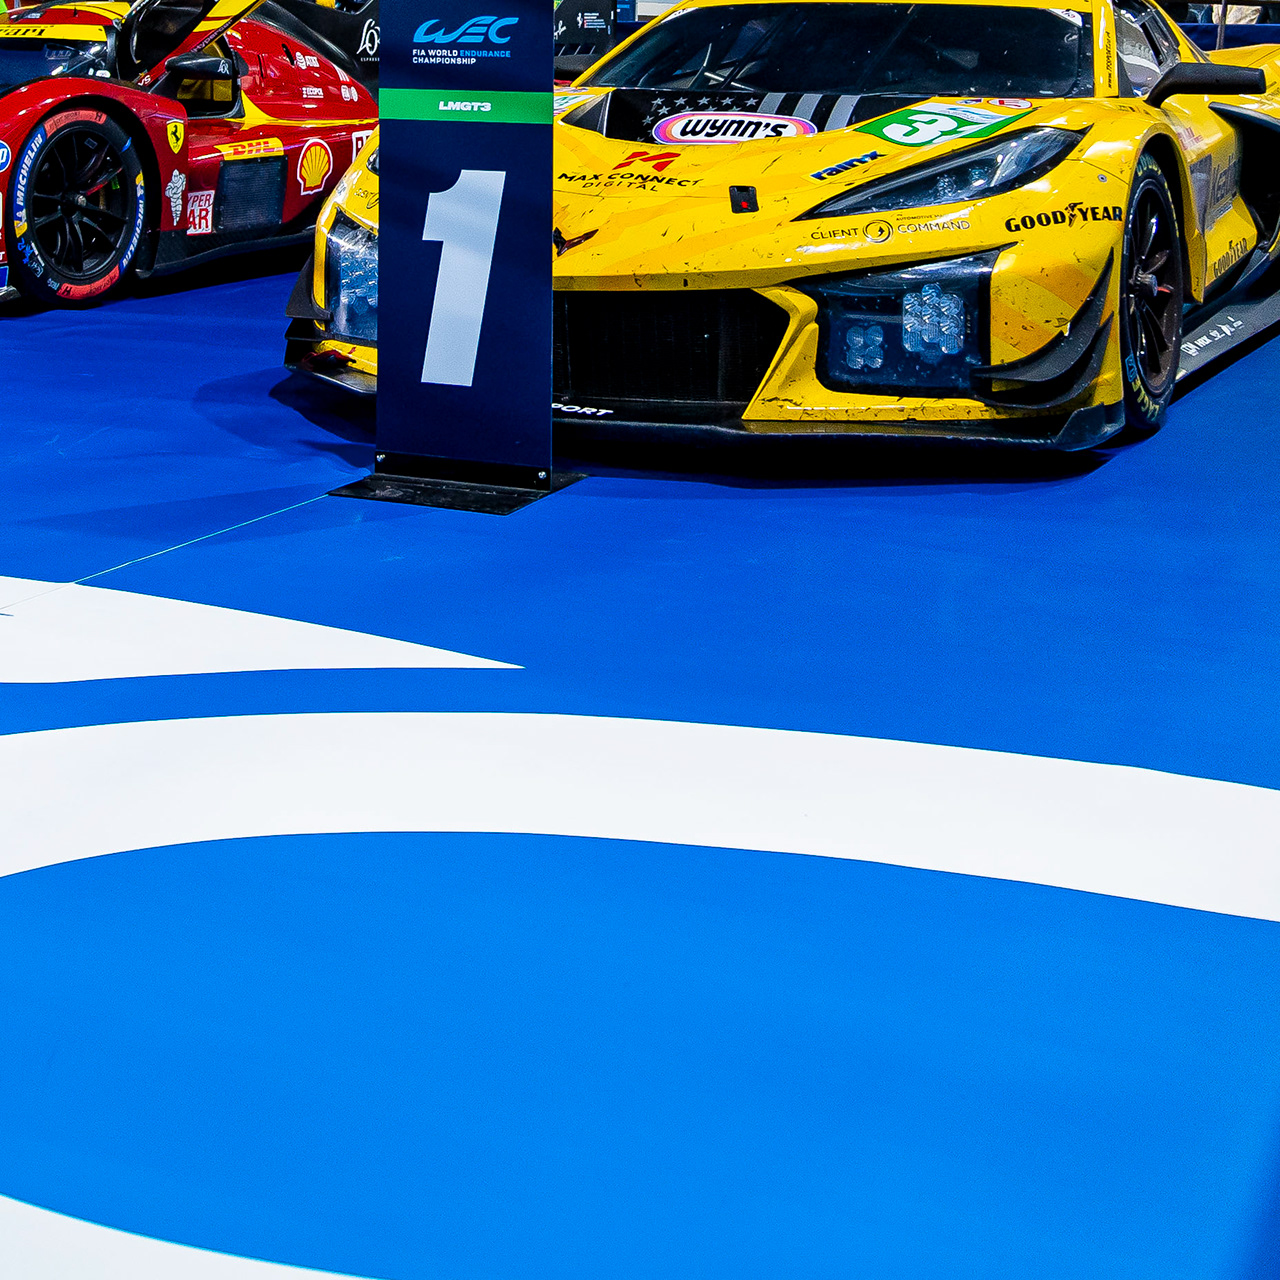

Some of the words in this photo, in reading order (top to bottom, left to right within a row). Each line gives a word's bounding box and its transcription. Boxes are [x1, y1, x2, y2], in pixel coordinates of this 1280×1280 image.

[413, 16, 519, 44] WEC
[413, 49, 426, 57] FIA
[428, 49, 458, 57] WORLD
[460, 50, 511, 58] ENDURANCE
[413, 57, 477, 65] CHAMPIONSHIP
[439, 101, 491, 111] LMGT3
[228, 141, 271, 156] DHL
[16, 133, 43, 206] MICHELIN
[557, 172, 604, 182] MAX
[607, 172, 704, 187] CONNECT
[582, 181, 658, 192] DIGITAL
[187, 208, 209, 231] AR
[810, 226, 859, 241] CLIENT
[897, 219, 970, 235] COMMAND
[421, 169, 507, 387] 1
